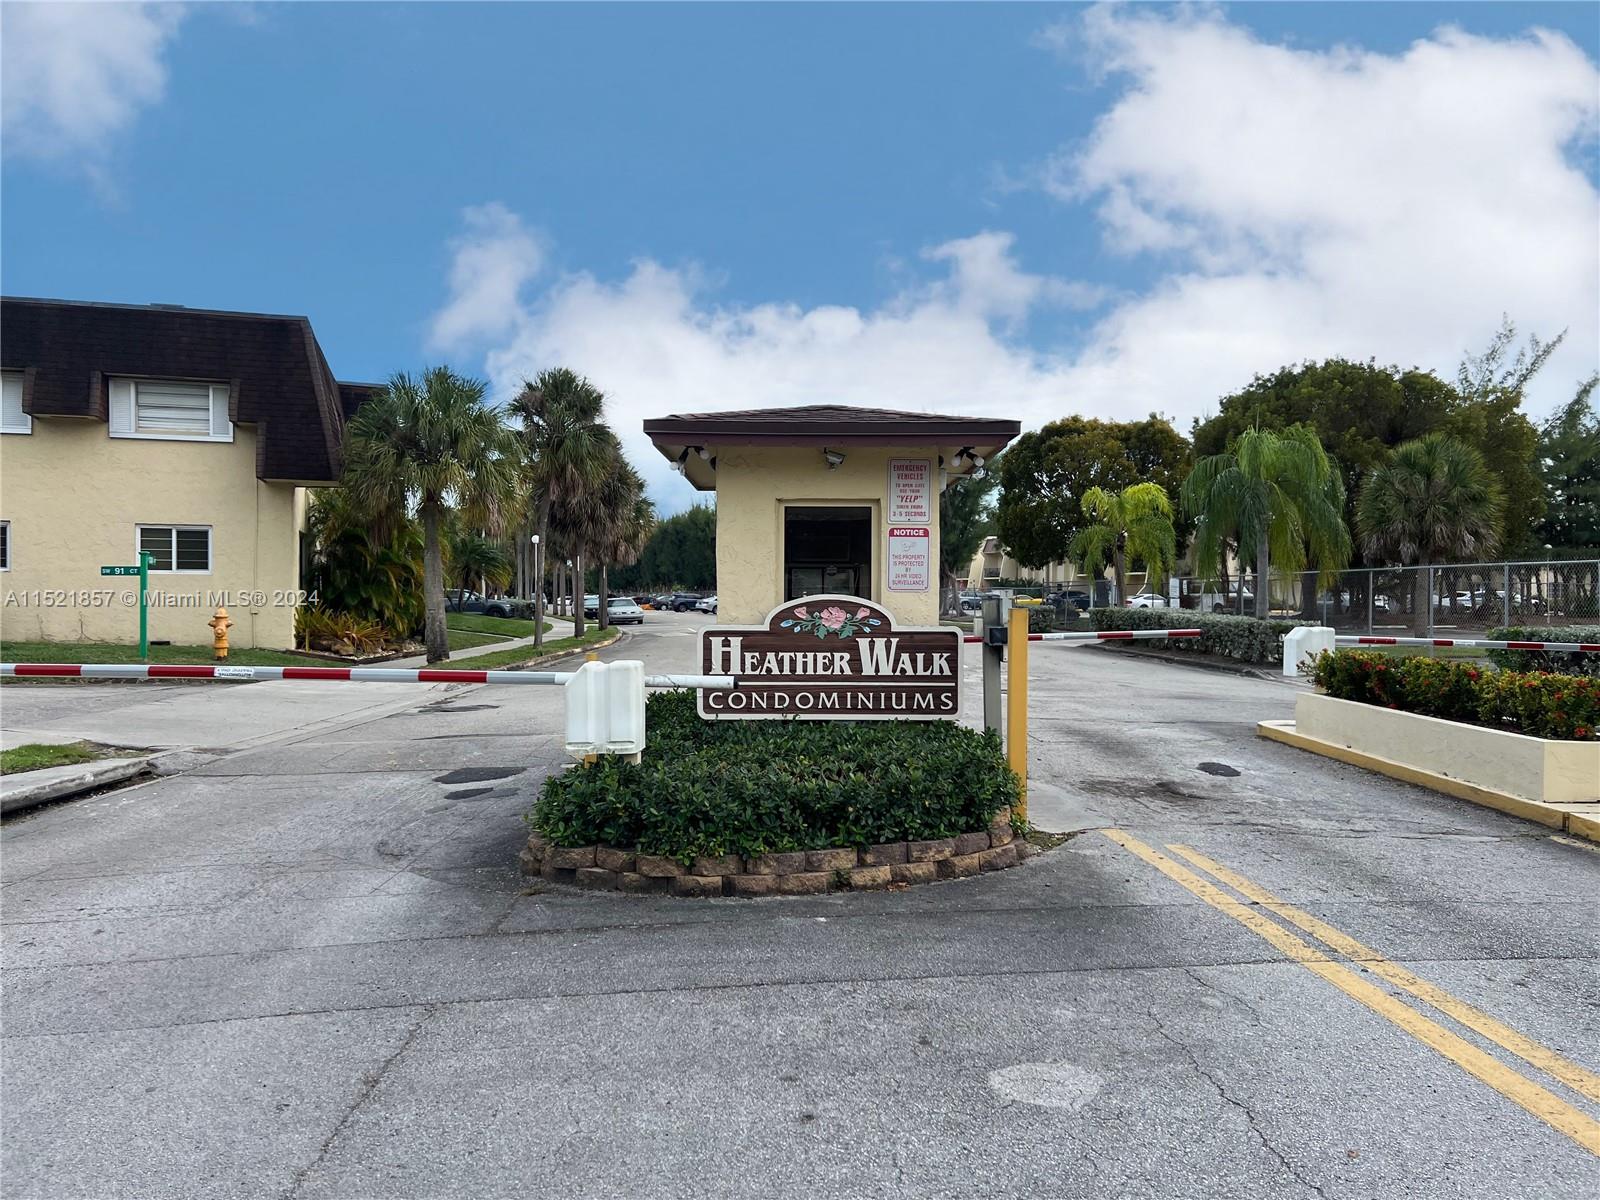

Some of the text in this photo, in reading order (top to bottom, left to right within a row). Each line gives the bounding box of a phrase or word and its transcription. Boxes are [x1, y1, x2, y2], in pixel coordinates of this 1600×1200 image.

[893, 464, 928, 472] EMERGENCY
[896, 472, 924, 480] VEHICLES
[896, 495, 924, 503] "YELP"
[114, 567, 125, 575] 91
[709, 636, 953, 676] HEATHER WALK
[708, 691, 954, 710] CONDOMINIUMS
